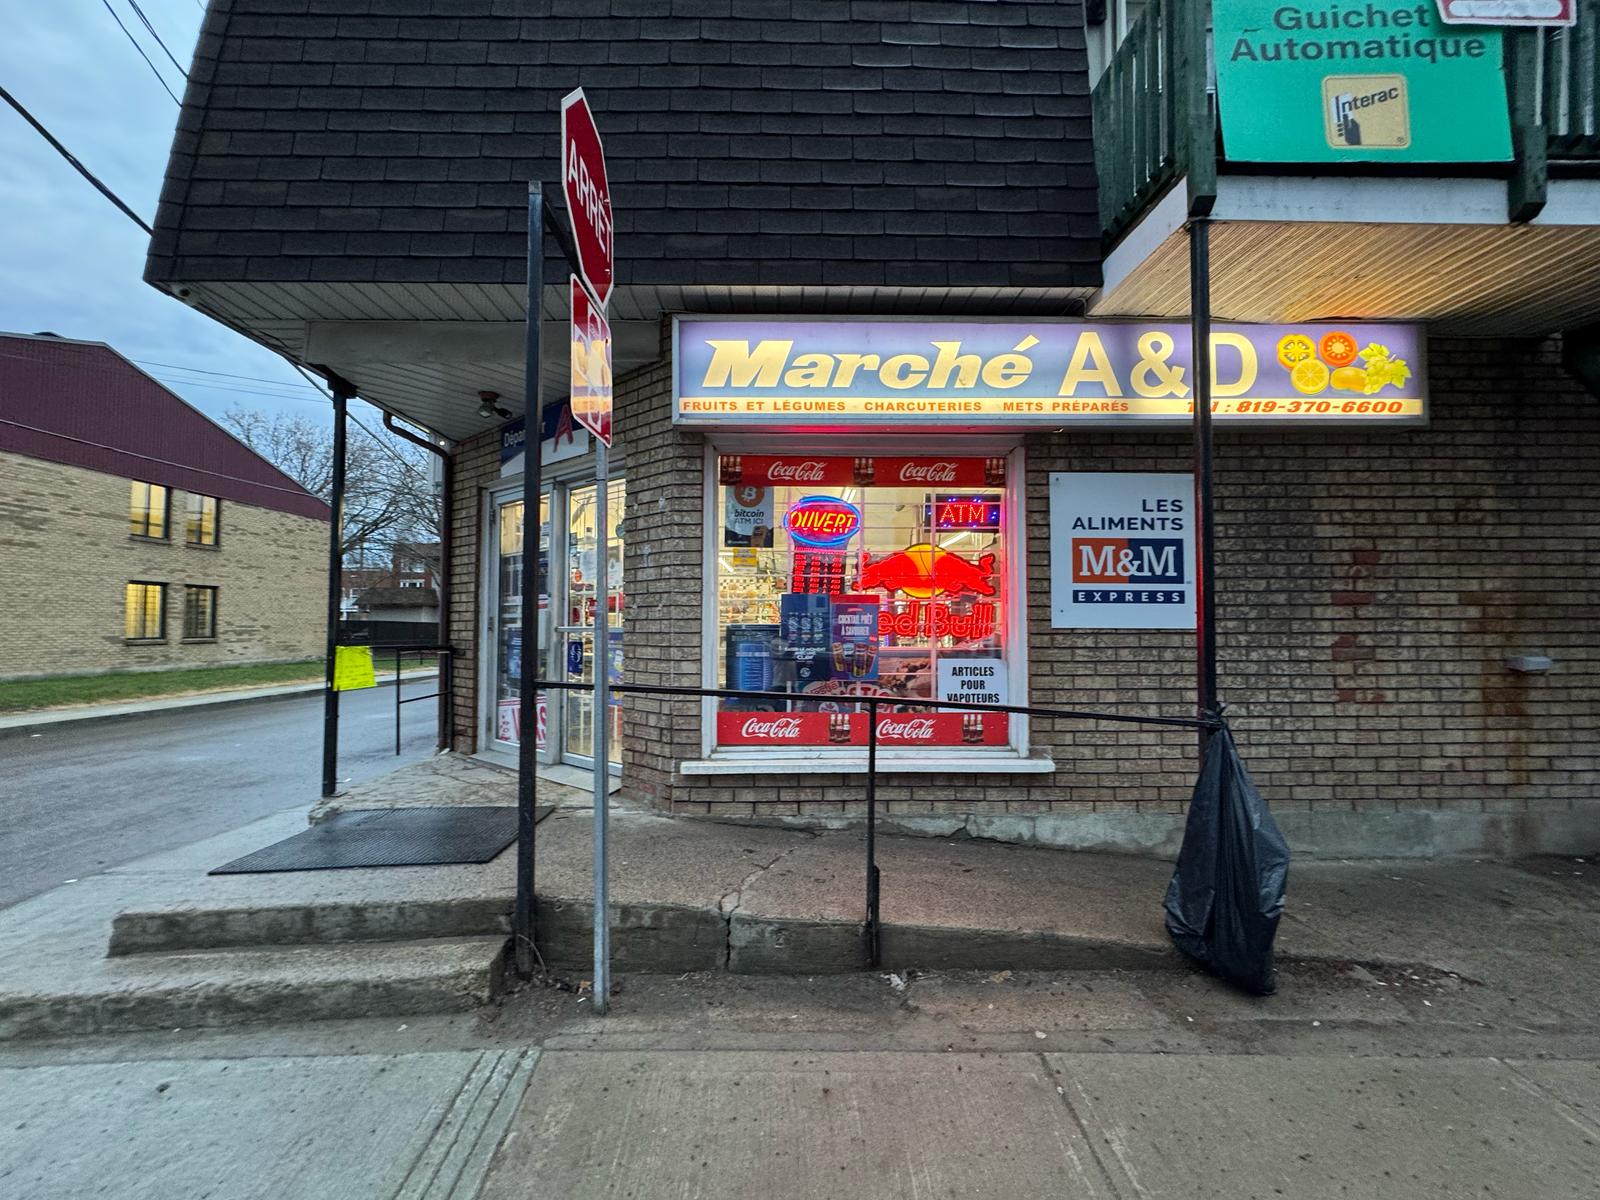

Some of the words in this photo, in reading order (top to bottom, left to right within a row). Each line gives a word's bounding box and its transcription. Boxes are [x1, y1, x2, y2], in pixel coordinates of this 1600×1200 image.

[1273, 4, 1431, 31] Guichet
[1231, 35, 1485, 63] Automatique
[1335, 87, 1399, 123] Interac
[702, 334, 1040, 389] Marché
[683, 401, 738, 411] FRUITS
[746, 401, 765, 411] ET
[773, 399, 846, 411] LÉGUMES
[864, 401, 982, 411] CHARCUTERIES
[1003, 402, 1044, 411] METS
[1052, 400, 1129, 412] PRÉPARÉS
[1236, 401, 1403, 412] 819-370-6600
[767, 461, 827, 481] Coca-Cola
[899, 462, 960, 482] Coca-Cola
[734, 509, 764, 517] bitcoin
[940, 504, 984, 523] ATM
[1142, 499, 1183, 512] LES
[790, 511, 856, 533] OUVERT
[1072, 517, 1184, 531] ALIMENTS
[1079, 545, 1178, 577] M&M
[1078, 592, 1181, 602] EXPRESS
[878, 600, 919, 636] ed
[925, 603, 993, 638] Bull
[952, 667, 994, 677] ARTICLES
[961, 680, 985, 690] POUR
[947, 693, 1000, 704] VAPOTEURS
[741, 717, 803, 738] Coca-Cola
[876, 719, 936, 739] Coca-Cola
